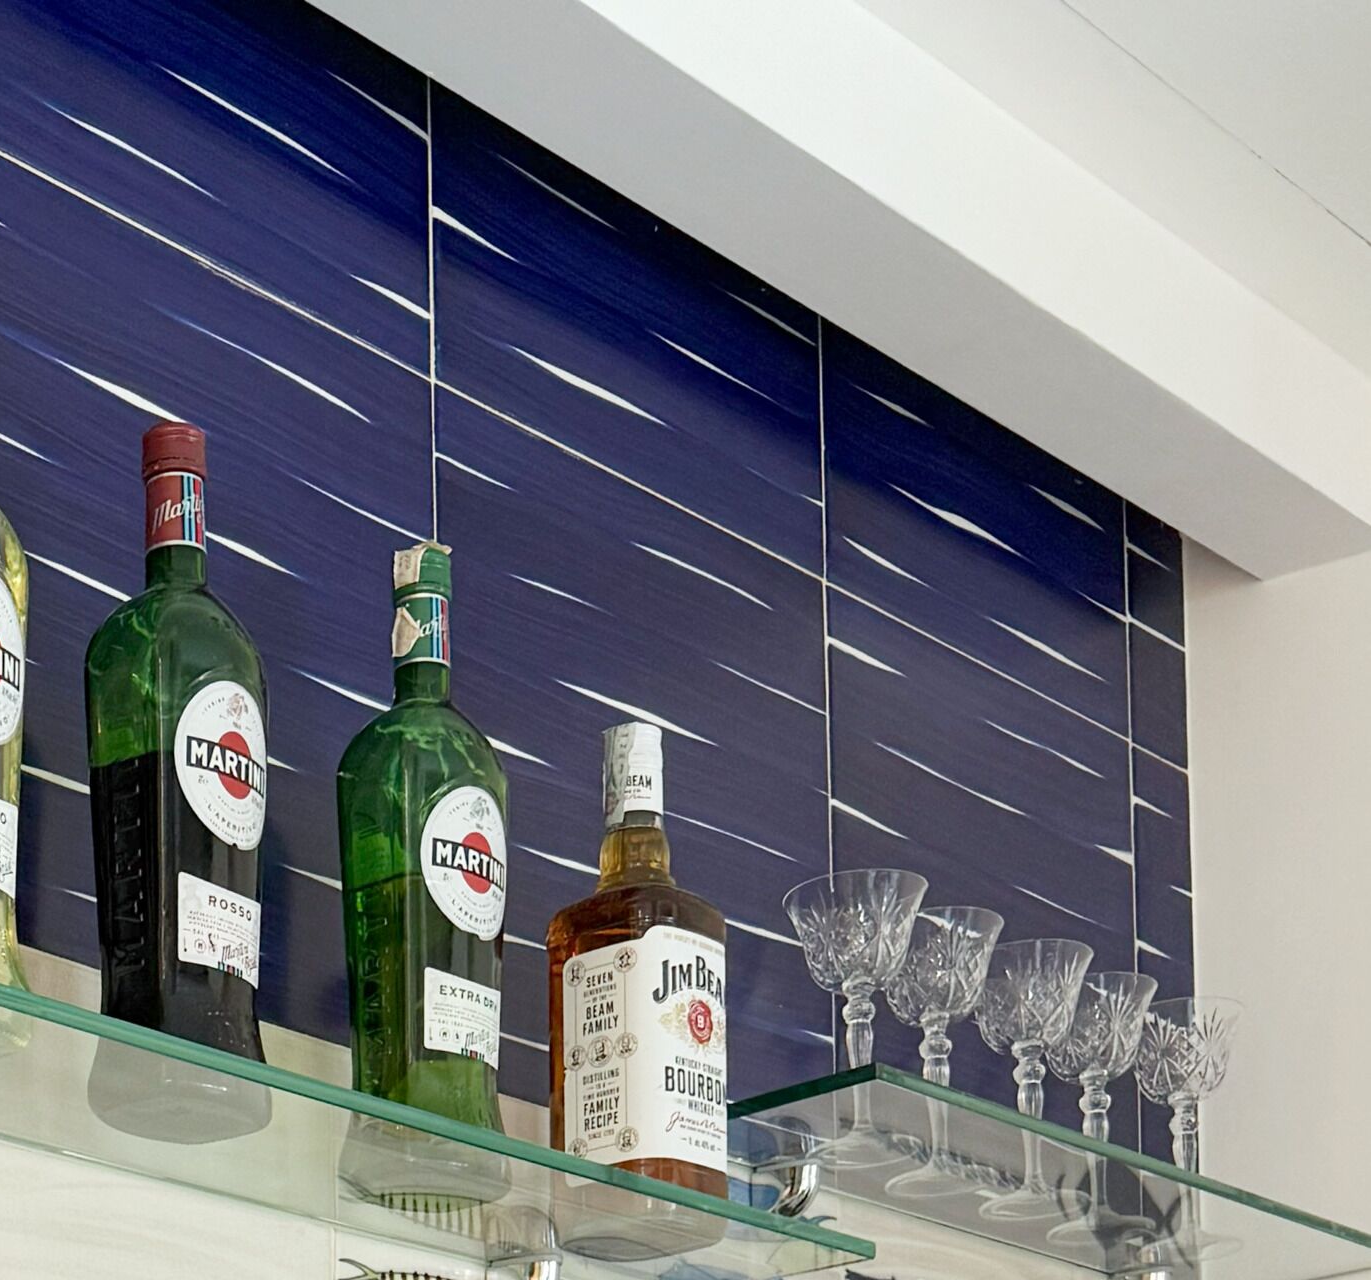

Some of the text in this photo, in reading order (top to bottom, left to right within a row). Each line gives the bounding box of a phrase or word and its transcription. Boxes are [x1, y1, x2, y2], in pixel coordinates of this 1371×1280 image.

[190, 740, 265, 794] MARTINI
[436, 841, 505, 892] MARTINI
[208, 895, 252, 922] ROSSO
[586, 971, 614, 988] SEVEN
[652, 959, 693, 1005] JIM
[440, 984, 481, 1004] EXTRA
[586, 1000, 615, 1020] BEAM
[582, 1015, 619, 1037] FAMILY
[582, 1068, 620, 1086] DISTILLING
[583, 1096, 620, 1117] FAMILY
[584, 1111, 619, 1132] RECIPE
